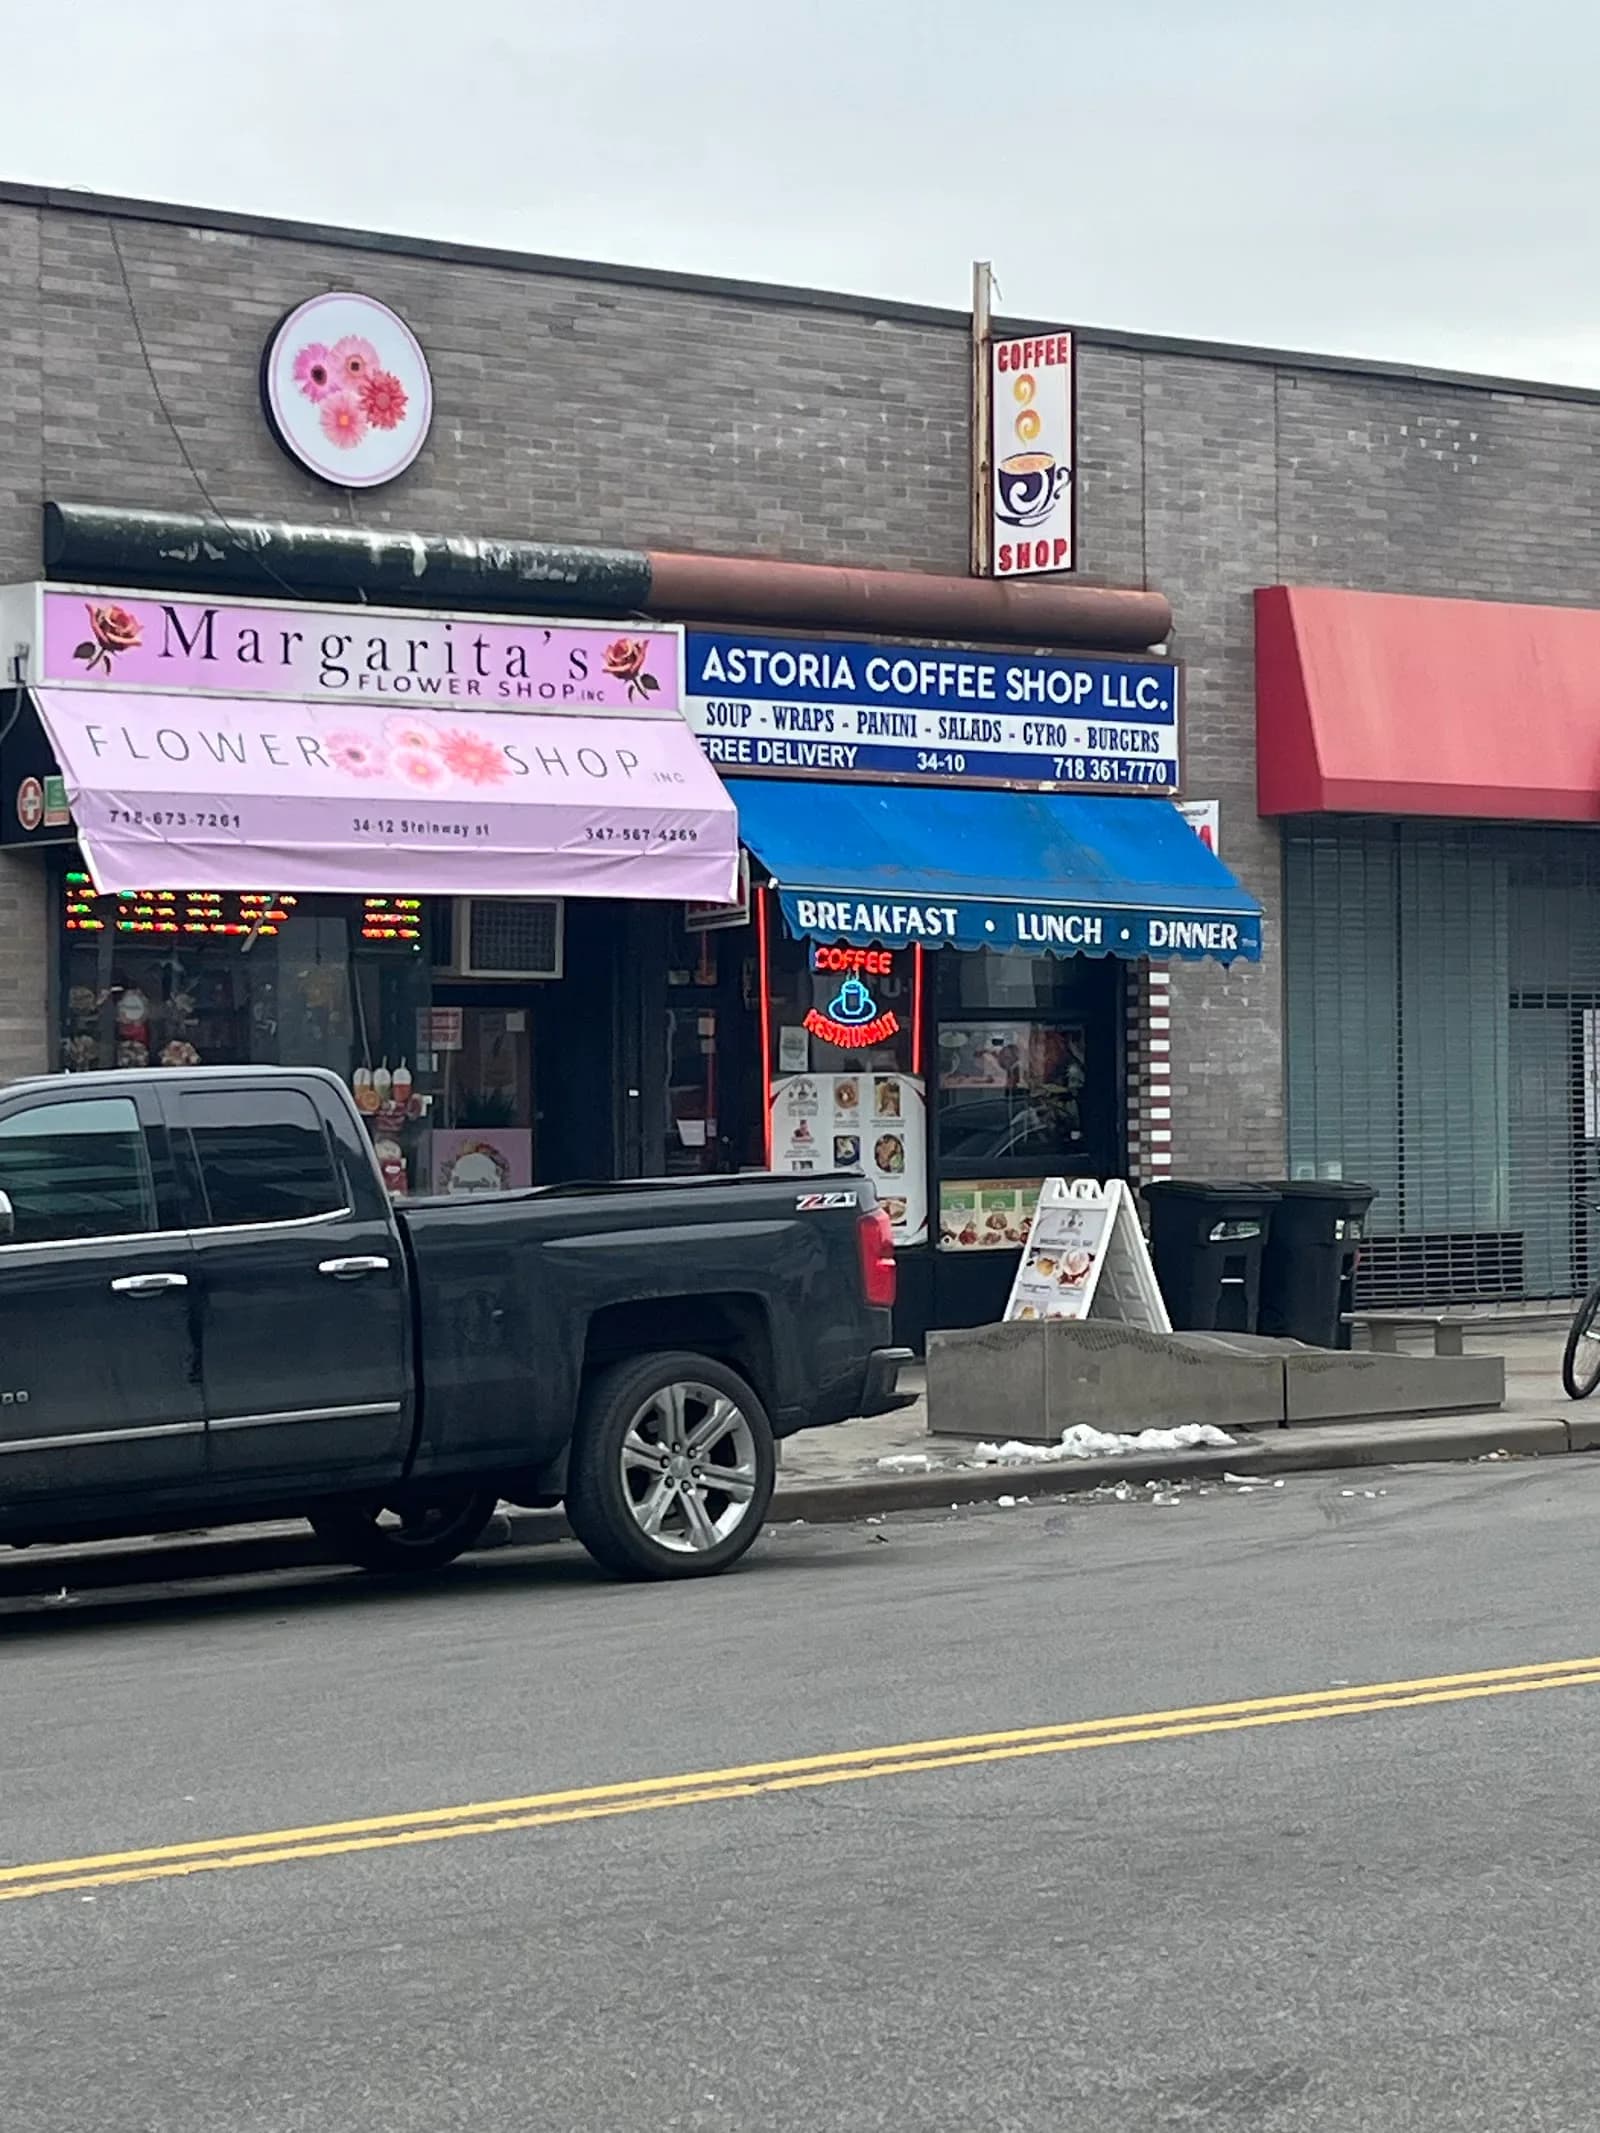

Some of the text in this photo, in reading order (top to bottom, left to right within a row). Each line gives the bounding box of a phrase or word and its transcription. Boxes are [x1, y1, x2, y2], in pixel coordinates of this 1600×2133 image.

[997, 336, 1067, 372] COFFEE
[999, 538, 1068, 572] SHOP
[158, 605, 589, 688] Margarita's
[359, 674, 481, 696] FLOWER
[498, 681, 575, 700] SHOP
[702, 646, 1168, 711] ASTORIA COFFEE SHOP LLC.
[706, 702, 751, 727] SOUP
[772, 705, 834, 732] WRAPS
[857, 710, 917, 738] PANINI
[938, 716, 1001, 743] SALADS
[1023, 721, 1067, 747] GYRO
[1088, 726, 1159, 753] BURGERS
[85, 725, 330, 767] FLOWER
[503, 744, 639, 778] SHOP
[757, 741, 858, 768] DELIVERY
[916, 751, 966, 772] 34-10
[1053, 757, 1085, 780] 718
[1090, 760, 1167, 783] 361-7770
[401, 820, 469, 837] Steinway
[797, 899, 1238, 950] BREAKFAST LUNCH DINNER
[815, 947, 892, 974] COFFEE
[802, 1008, 899, 1048] RESTAURANT
